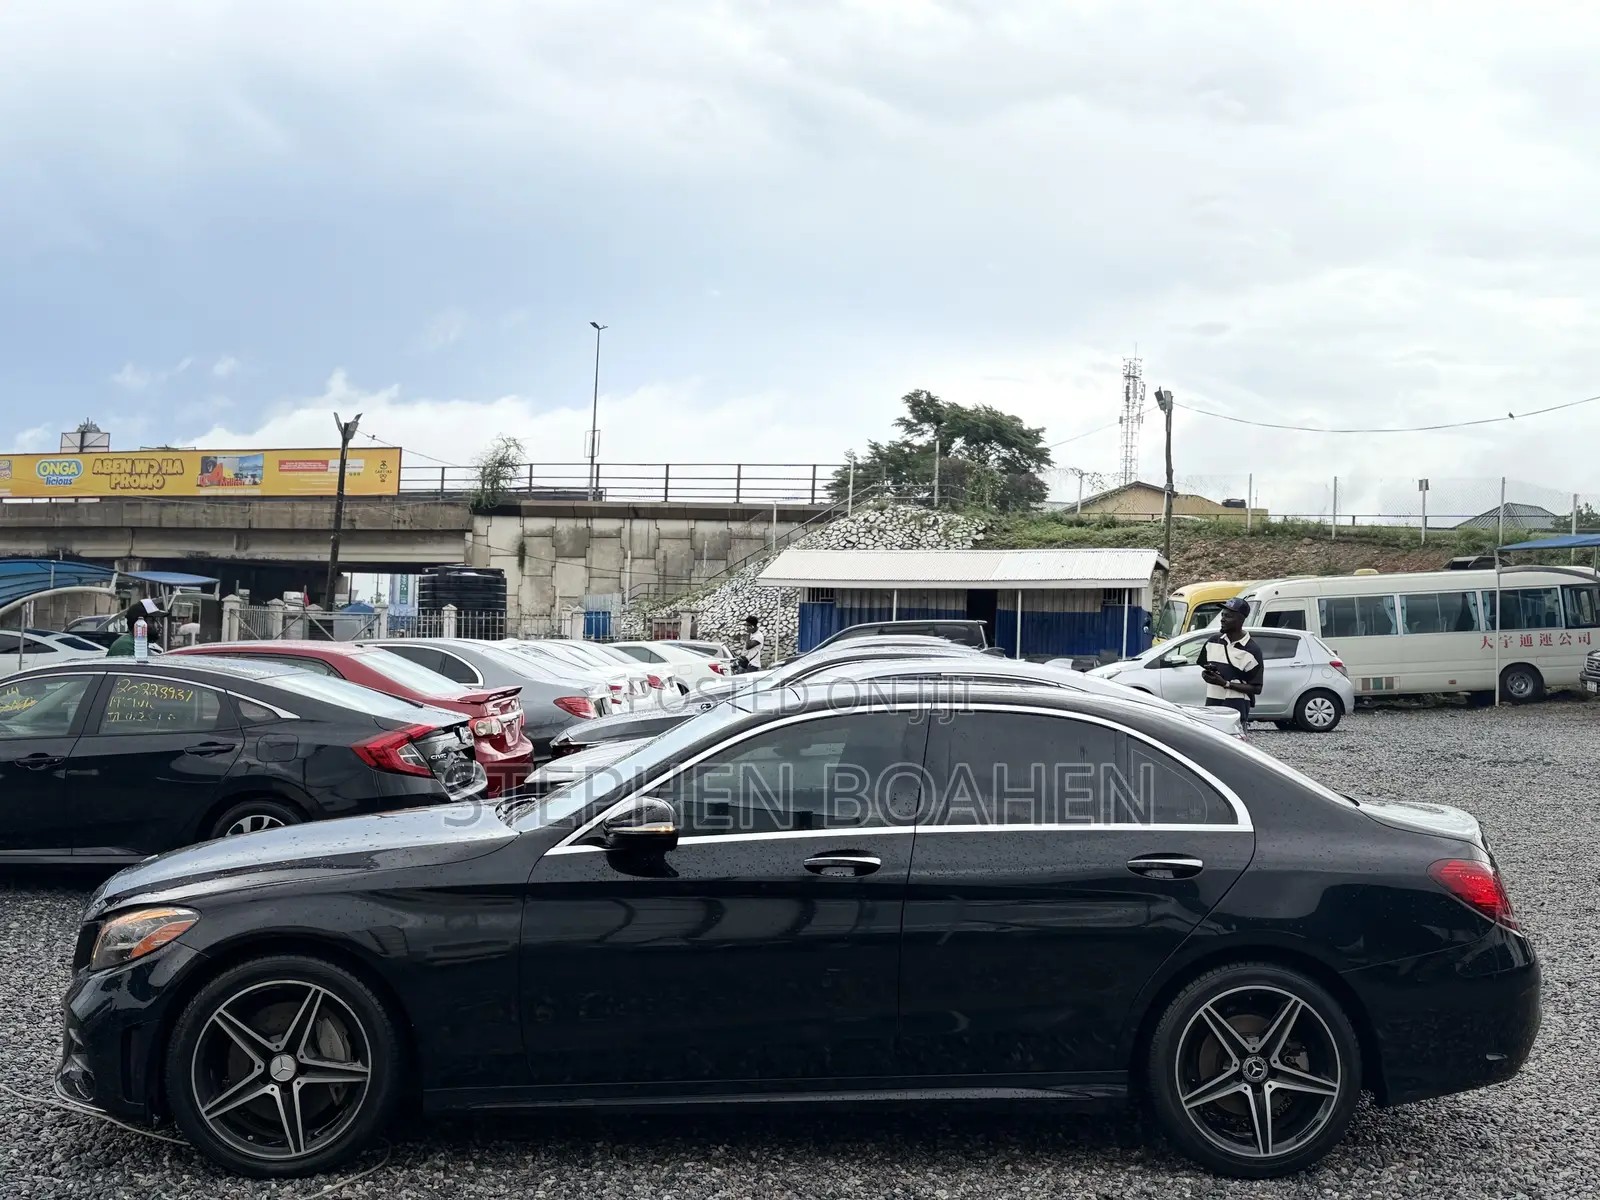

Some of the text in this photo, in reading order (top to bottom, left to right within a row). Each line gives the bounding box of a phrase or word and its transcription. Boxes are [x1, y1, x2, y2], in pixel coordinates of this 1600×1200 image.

[39, 461, 80, 476] ONGA
[45, 476, 73, 486] licious
[110, 473, 165, 490] PROMO
